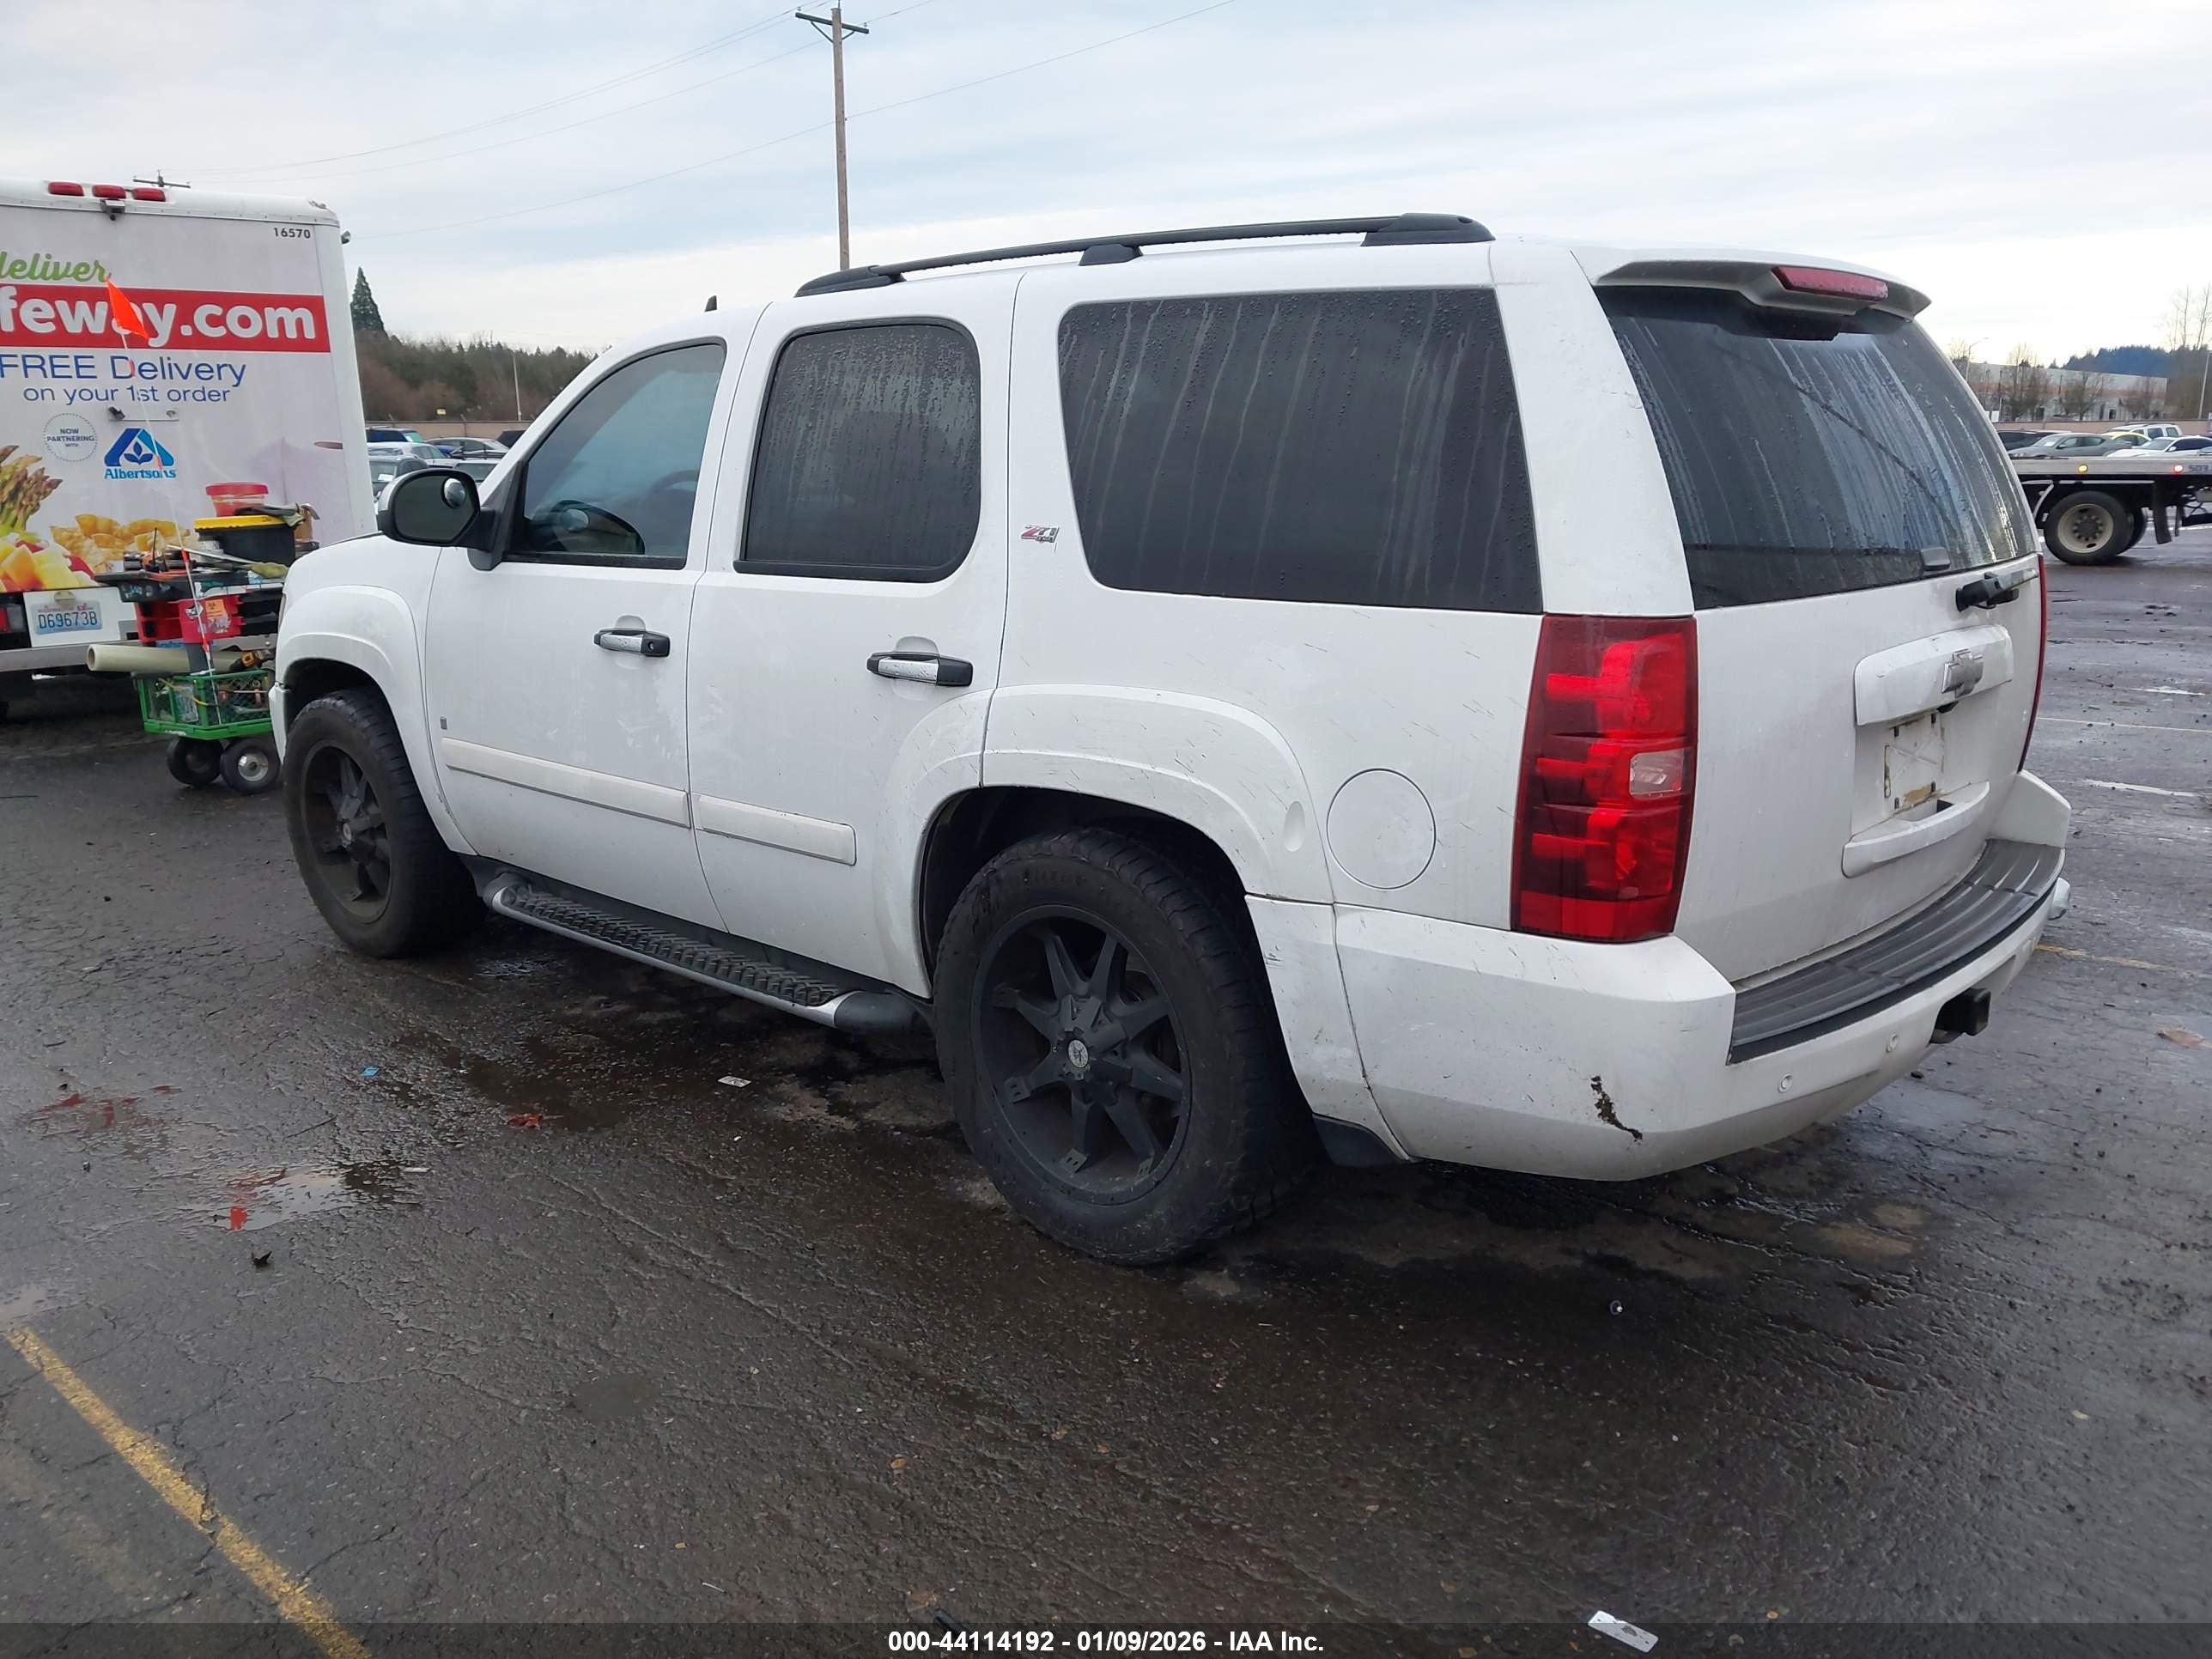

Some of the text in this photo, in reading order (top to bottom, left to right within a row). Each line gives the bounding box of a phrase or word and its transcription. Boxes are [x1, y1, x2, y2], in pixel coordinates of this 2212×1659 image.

[273, 227, 311, 239] 16570
[0, 354, 246, 387] FREE Delivery
[23, 386, 230, 405] on your 1st order
